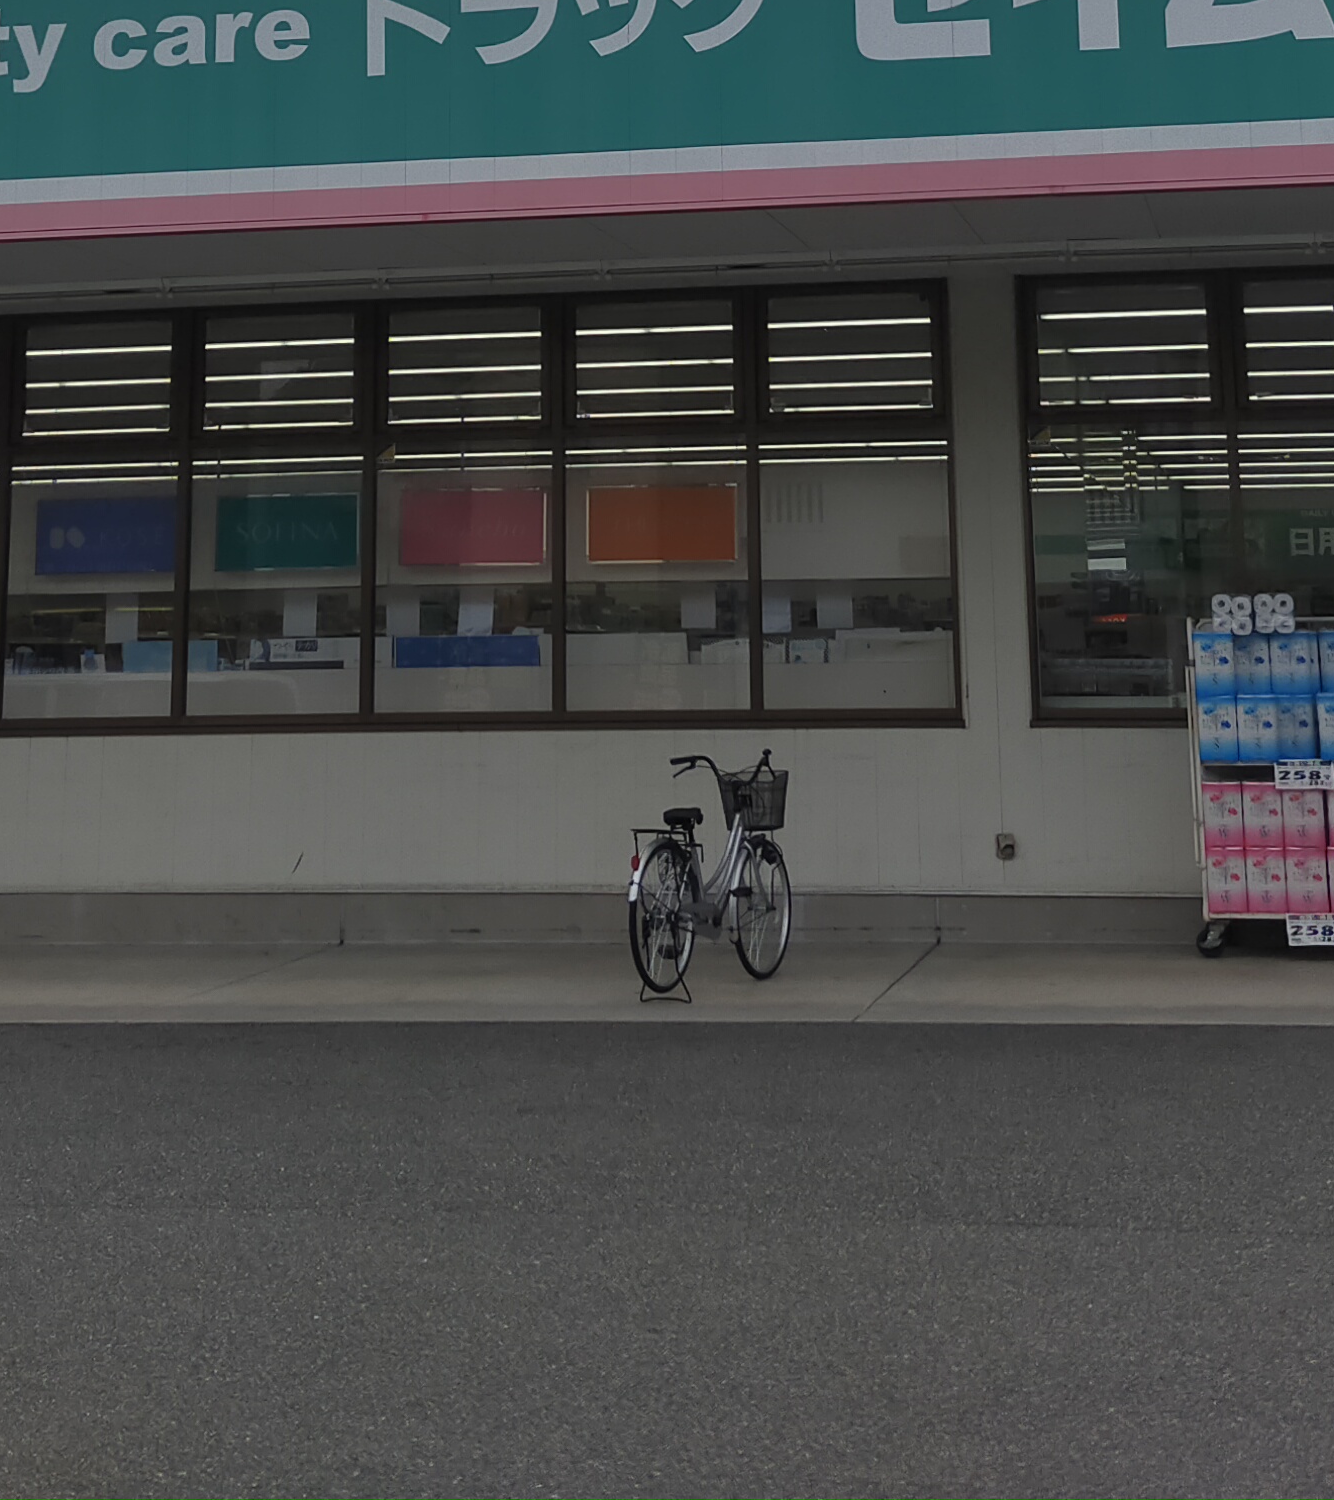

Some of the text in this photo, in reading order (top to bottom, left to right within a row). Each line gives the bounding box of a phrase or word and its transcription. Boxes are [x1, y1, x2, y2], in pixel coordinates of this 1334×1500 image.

[93, 9, 311, 70] care
[1278, 770, 1322, 780] 258
[1290, 925, 1334, 936] 258
